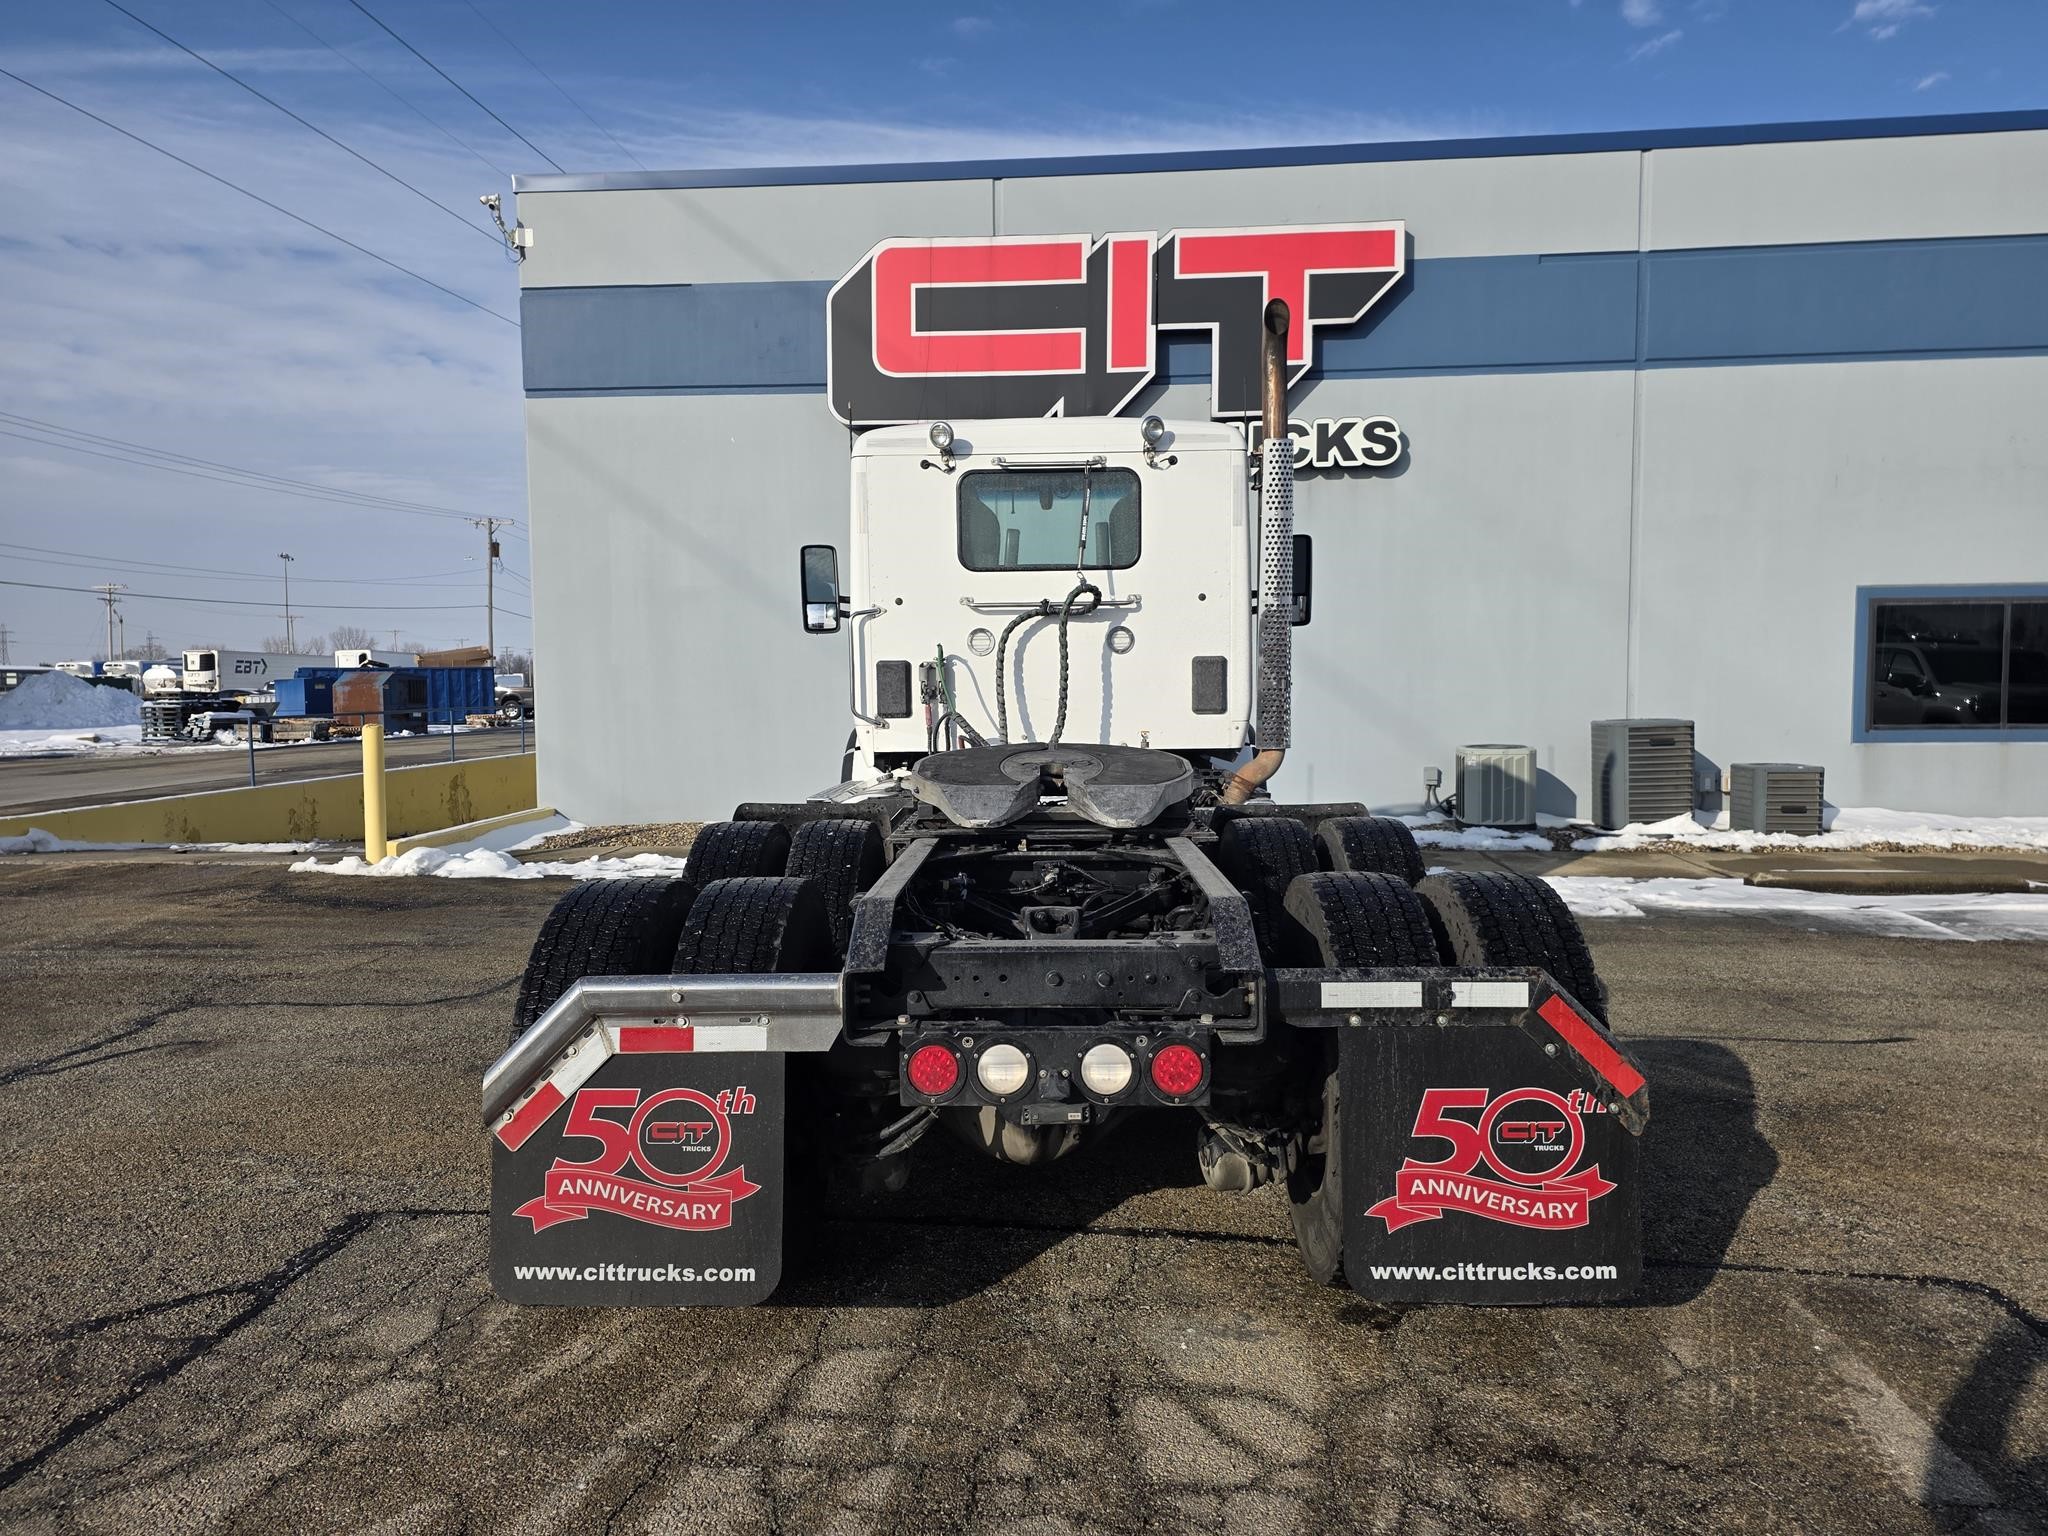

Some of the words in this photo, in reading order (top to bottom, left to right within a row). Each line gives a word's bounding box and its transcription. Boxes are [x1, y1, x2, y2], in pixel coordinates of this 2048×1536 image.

[827, 220, 1405, 416] CIT
[235, 659, 260, 674] EBT
[646, 1122, 713, 1144] CIT
[1497, 1122, 1565, 1143] CIT
[558, 1178, 722, 1220] ANNIVERSARY
[1410, 1178, 1578, 1219] ANNIVERSARY
[514, 1263, 756, 1282] www.cittrucks.com
[1370, 1262, 1617, 1281] www.cittrucks.com
